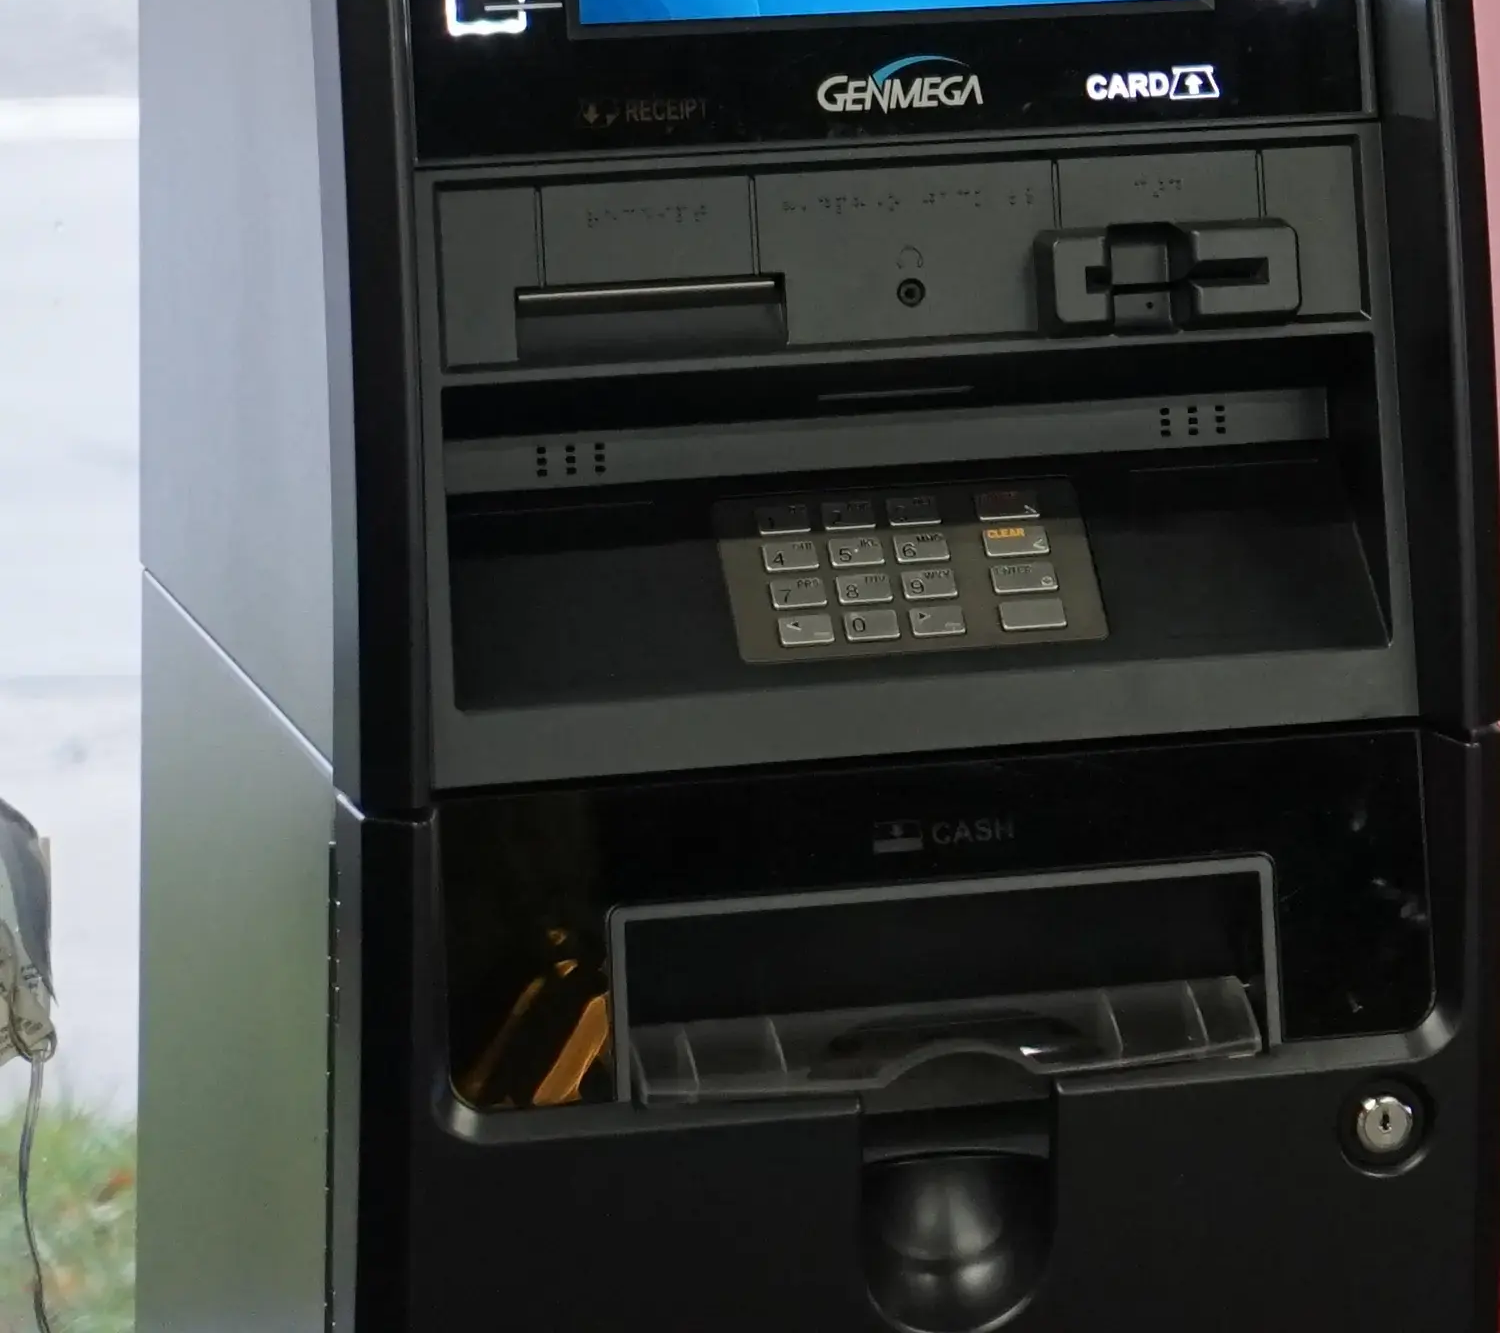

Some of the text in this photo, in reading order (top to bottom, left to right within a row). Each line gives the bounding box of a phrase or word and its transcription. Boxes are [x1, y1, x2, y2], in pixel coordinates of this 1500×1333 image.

[816, 72, 984, 115] GENMEGA
[1086, 73, 1169, 101] CARD
[624, 99, 708, 124] RECEIPT
[987, 528, 1025, 538] CLEAR
[932, 817, 1015, 845] CASH
